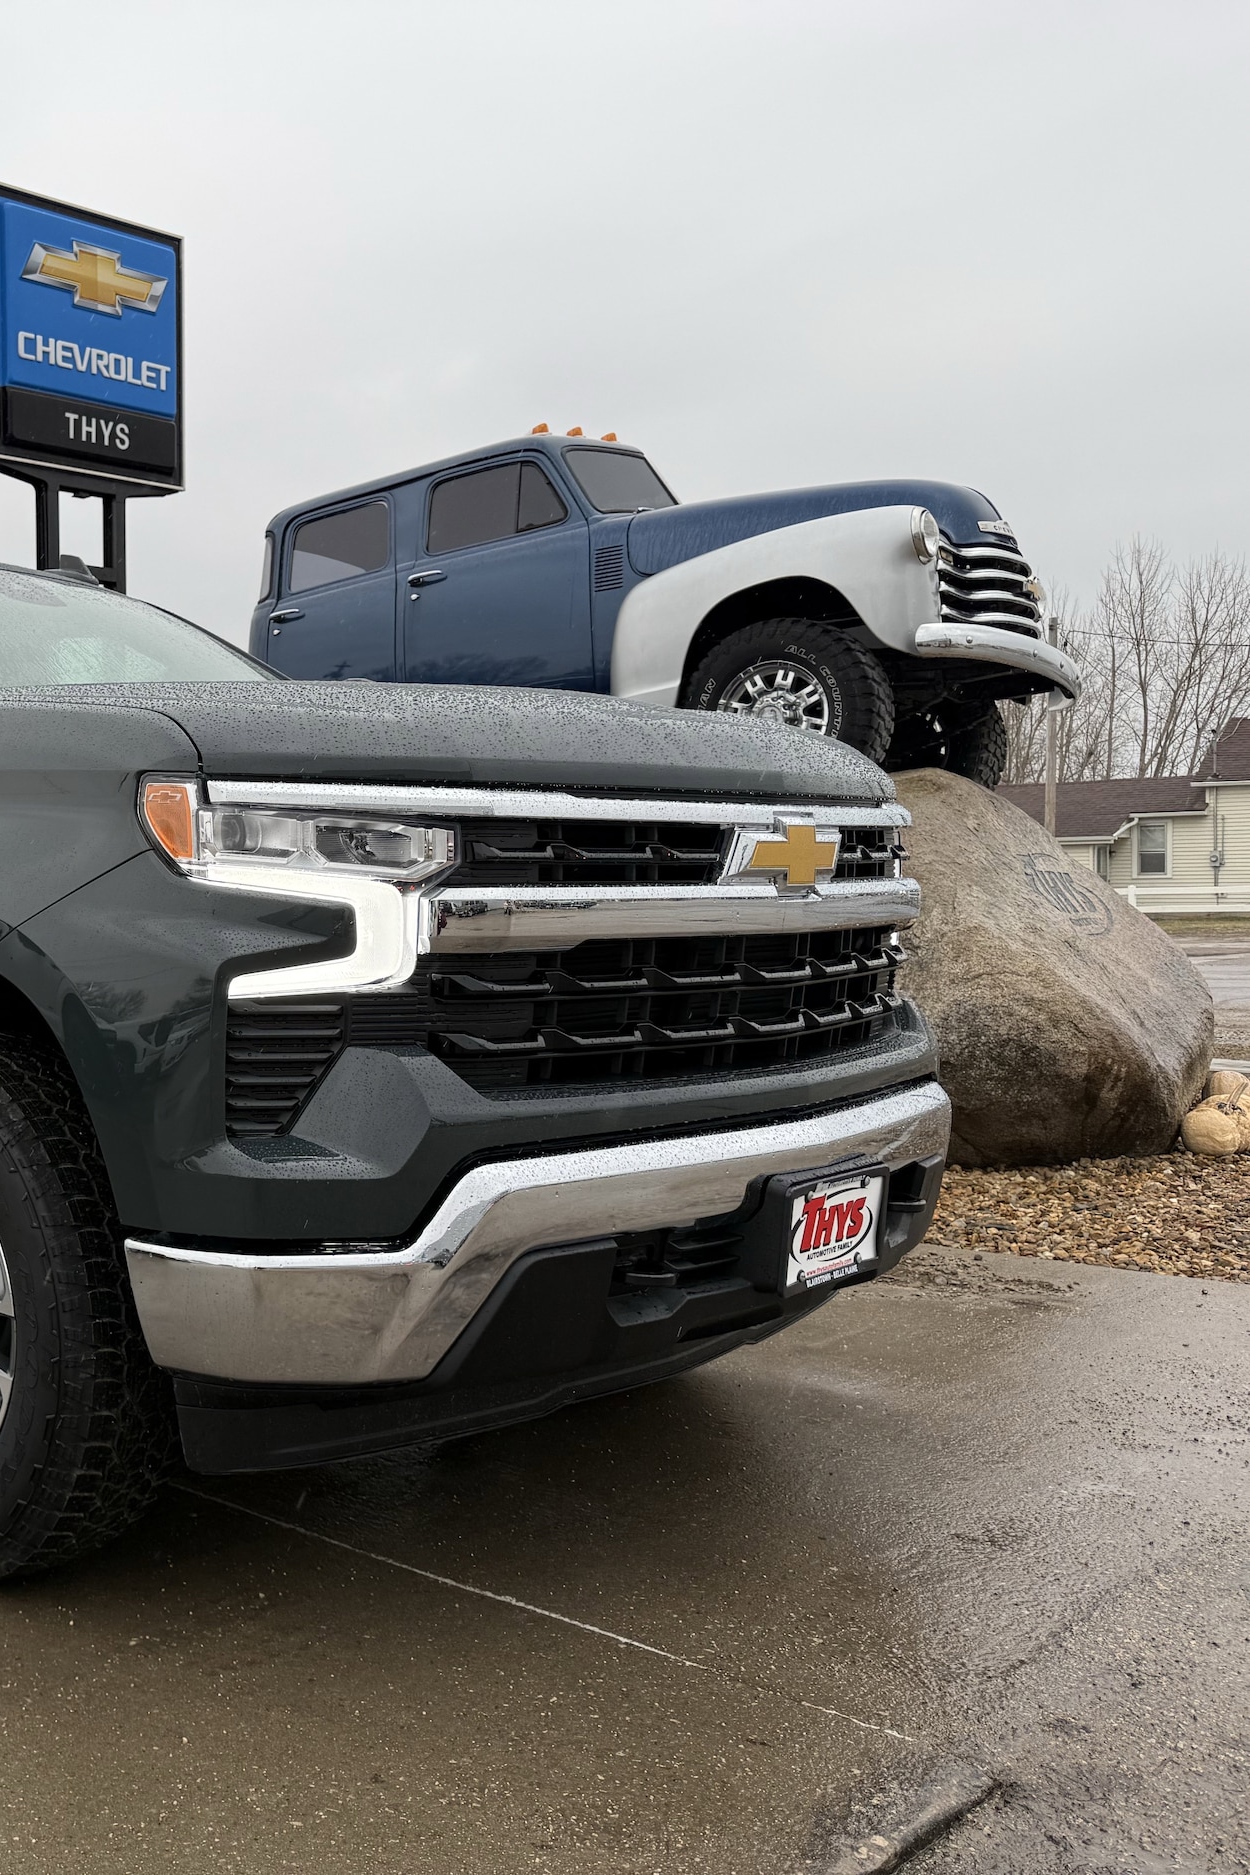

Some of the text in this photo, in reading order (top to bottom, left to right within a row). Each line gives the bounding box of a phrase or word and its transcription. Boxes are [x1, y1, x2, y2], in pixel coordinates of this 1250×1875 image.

[18, 331, 171, 391] CHEVROLET
[65, 412, 130, 450] THYS
[784, 644, 817, 666] ALL
[1017, 853, 1098, 915] THYS
[800, 1193, 867, 1253] THYS
[807, 1241, 853, 1260] AUTOMOTIVE FAMILY
[833, 1268, 845, 1279] BELLE
[844, 1264, 859, 1275] PLAINE
